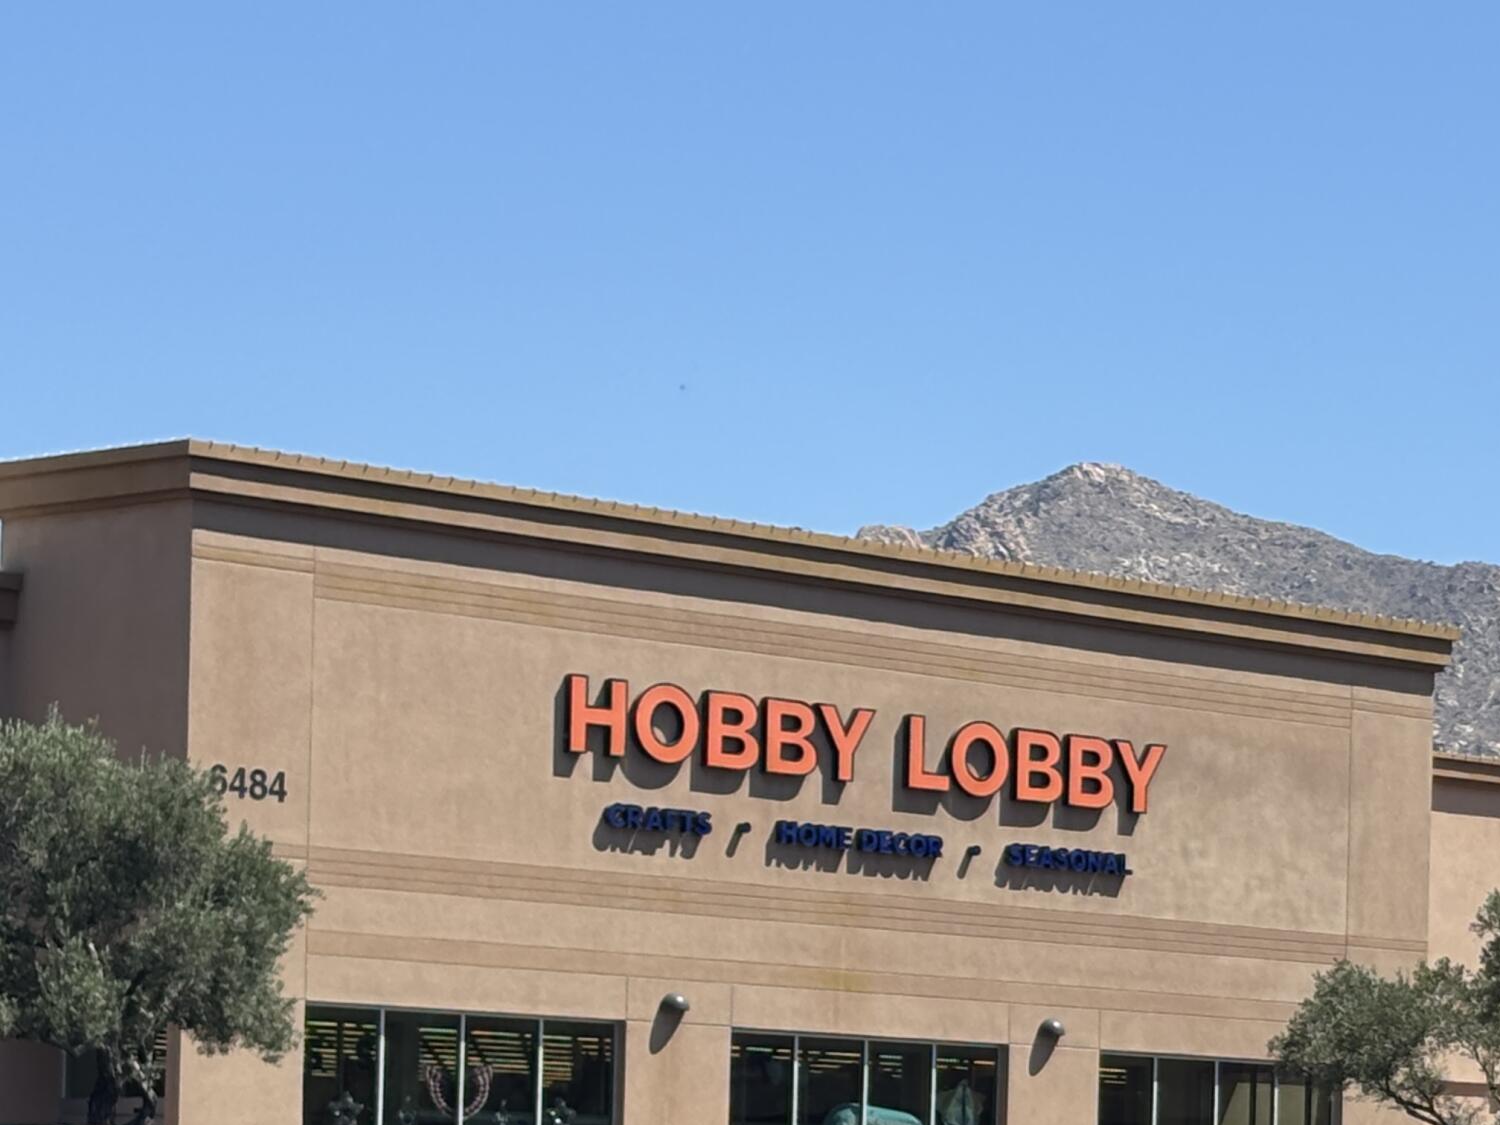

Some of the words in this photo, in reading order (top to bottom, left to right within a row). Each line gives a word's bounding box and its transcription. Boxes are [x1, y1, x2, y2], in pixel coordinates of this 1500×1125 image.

[563, 673, 876, 782] HOBBY
[903, 713, 1167, 814] LOBBY
[211, 764, 287, 803] 6484
[604, 803, 712, 836] CRAFTS
[775, 820, 852, 850] HOME
[857, 828, 943, 858] DECOR
[1003, 843, 1133, 876] SEASONAL
